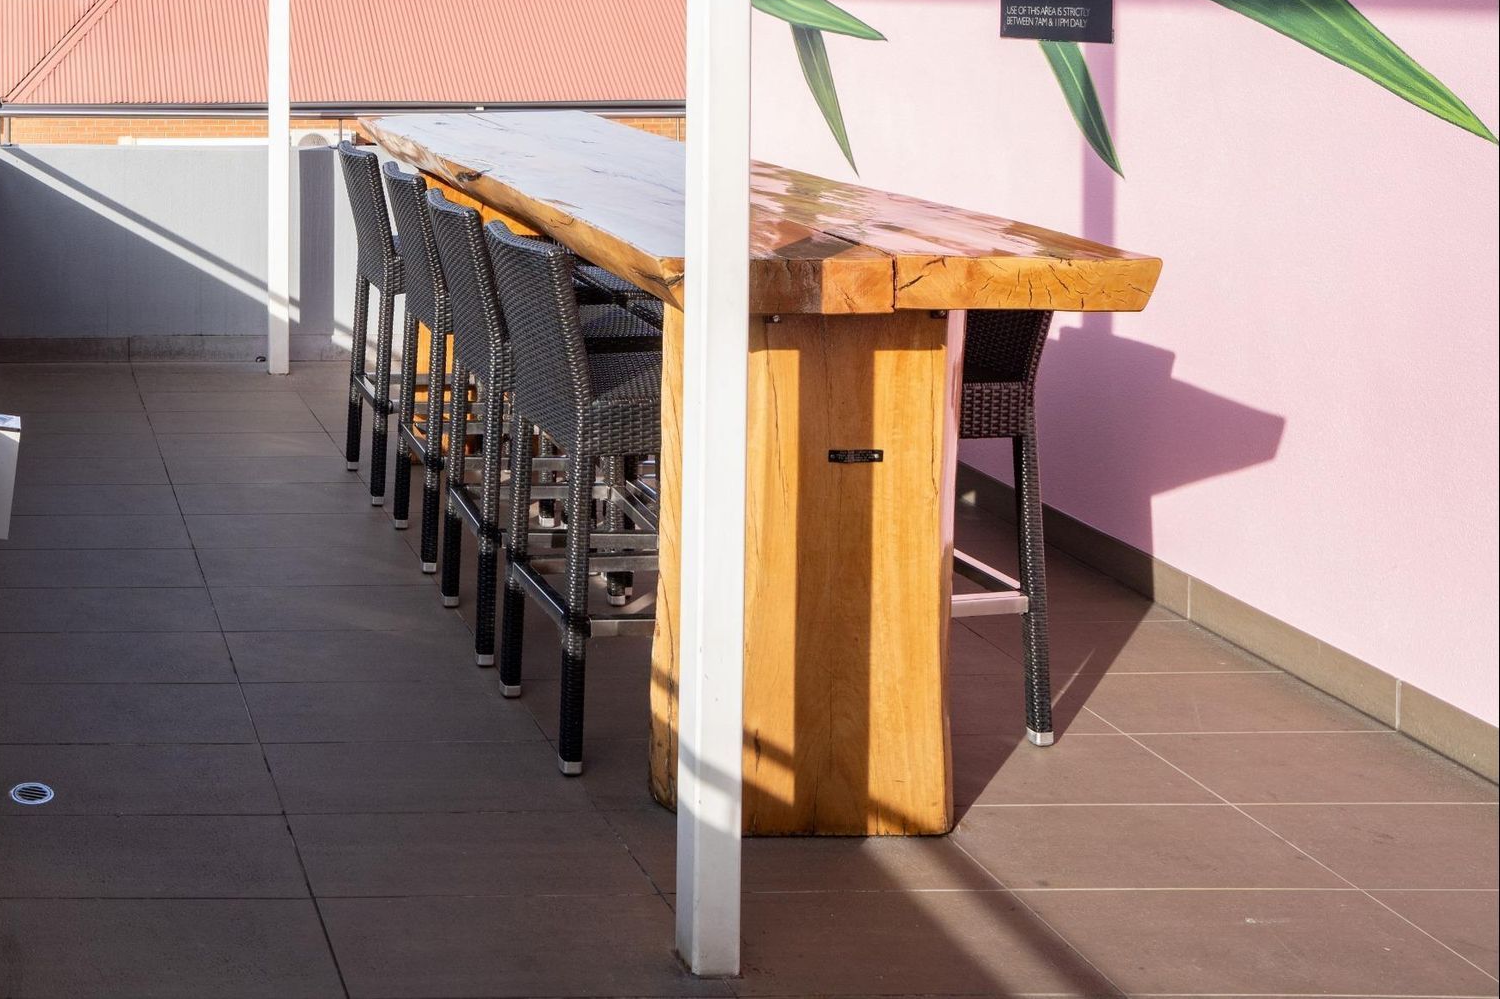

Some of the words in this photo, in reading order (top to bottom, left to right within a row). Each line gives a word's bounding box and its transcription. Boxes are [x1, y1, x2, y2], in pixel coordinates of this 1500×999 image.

[1006, 5, 1017, 15] USE
[1018, 5, 1026, 15] OF
[1027, 6, 1040, 15] THIS
[1041, 6, 1056, 16] AREA
[1057, 7, 1062, 16] IS
[1063, 7, 1091, 17] STRICTLY
[1006, 16, 1034, 26] BETWEEN
[1035, 17, 1048, 26] 7AM
[1049, 18, 1053, 27] &
[1070, 18, 1088, 28] DAILY
